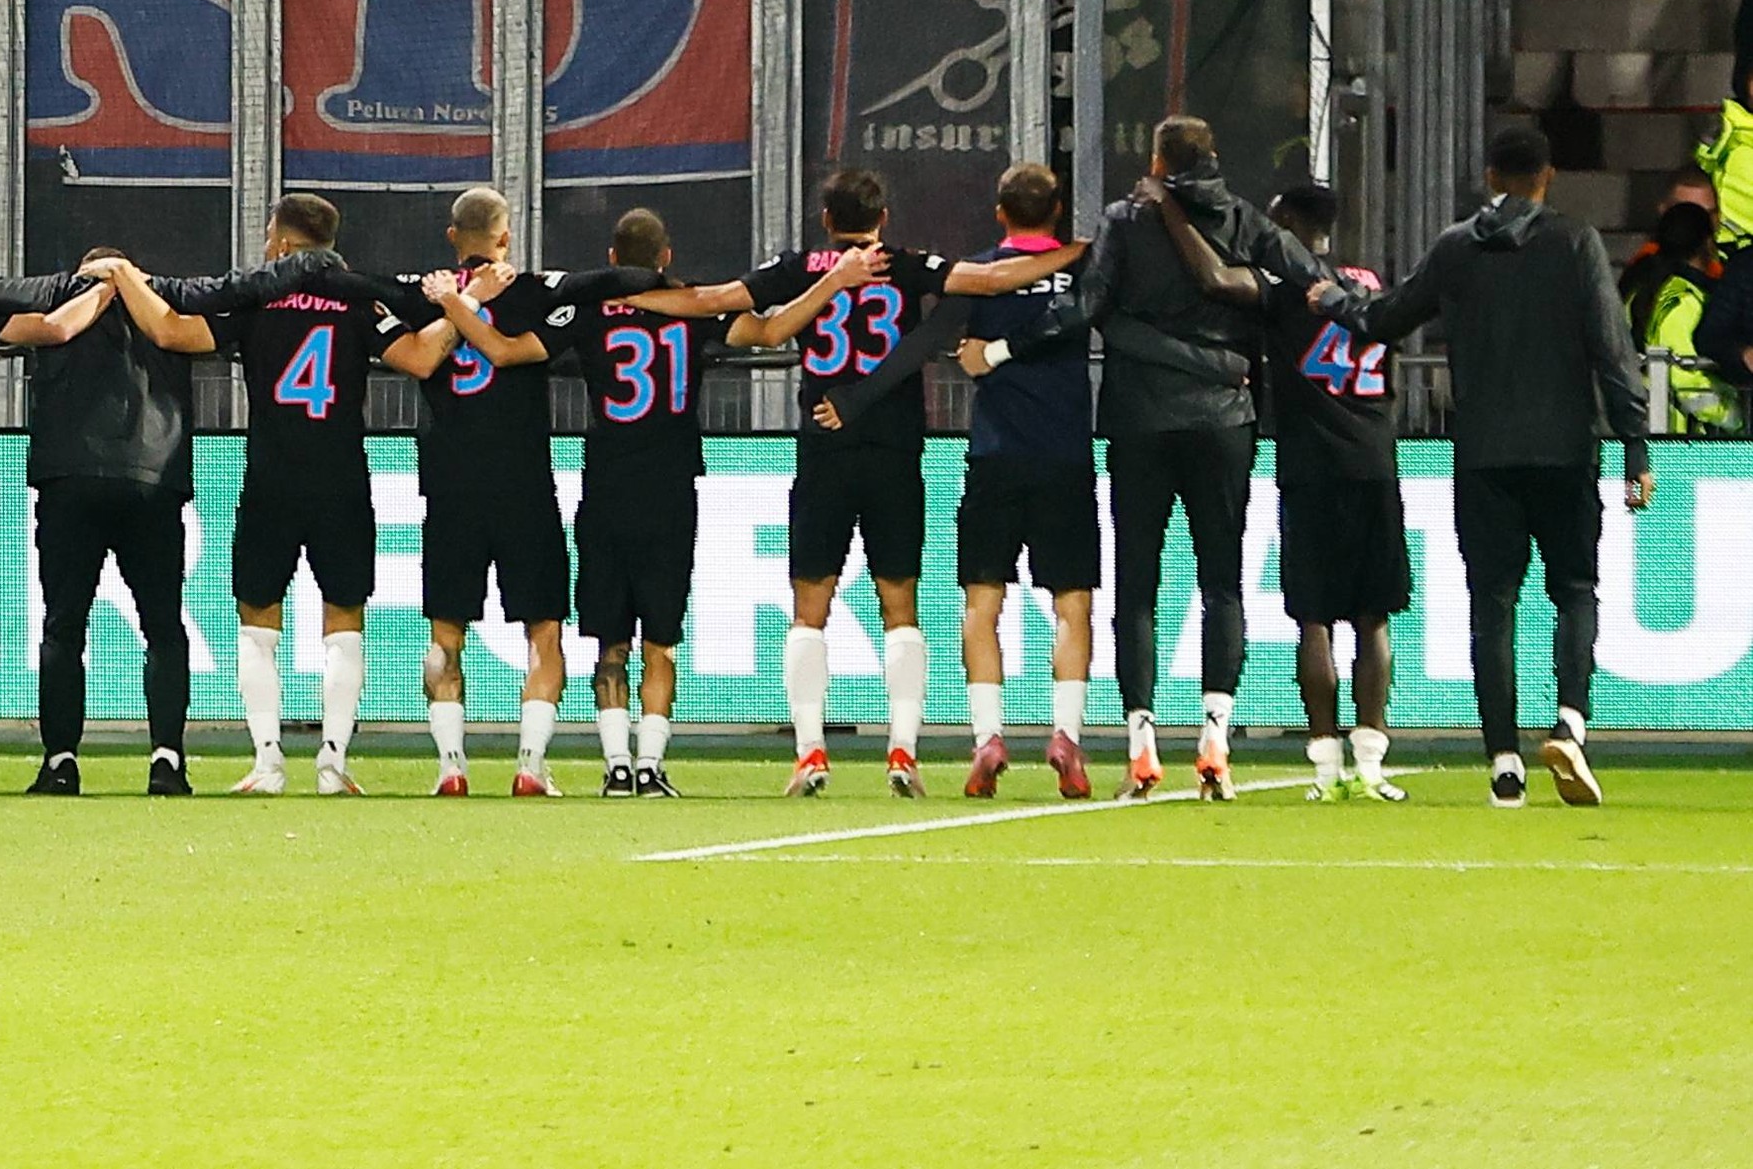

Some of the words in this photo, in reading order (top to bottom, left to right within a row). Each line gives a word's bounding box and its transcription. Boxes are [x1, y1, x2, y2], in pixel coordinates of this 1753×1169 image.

[273, 325, 336, 420] 4
[603, 321, 689, 423] 31
[802, 283, 903, 376] 33
